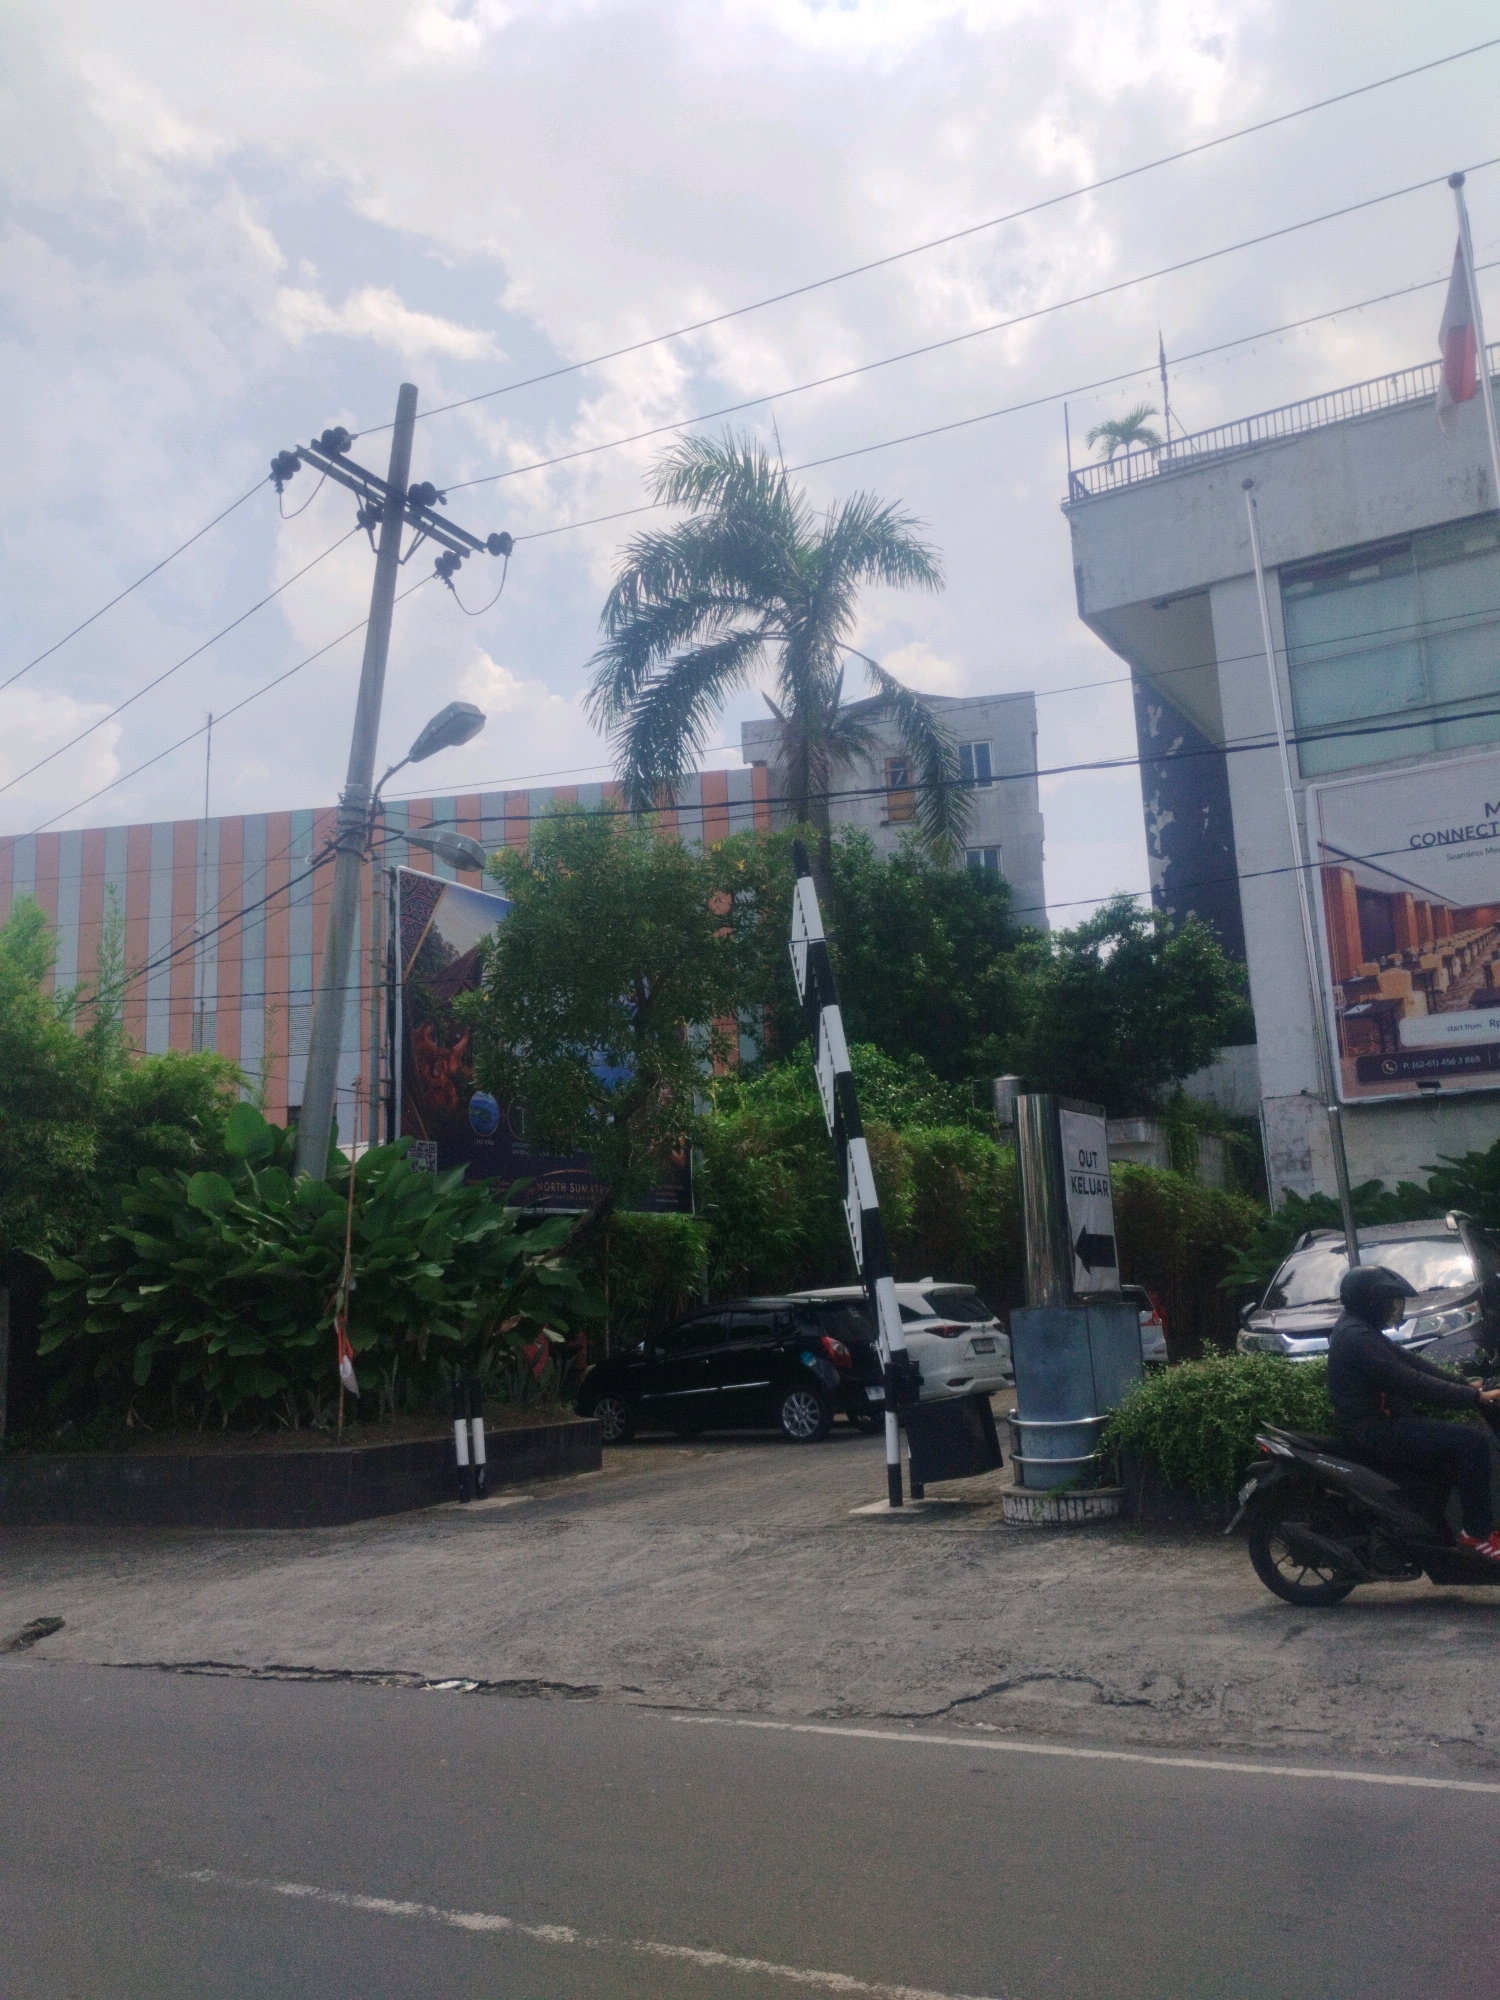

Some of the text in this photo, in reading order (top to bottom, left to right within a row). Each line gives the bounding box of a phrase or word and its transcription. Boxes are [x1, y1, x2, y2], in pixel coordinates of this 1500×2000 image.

[1409, 821, 1499, 848] CONNECT
[1446, 849, 1483, 861] Seamless
[1446, 1024, 1463, 1032] start
[1464, 1023, 1482, 1031] from
[1078, 1149, 1097, 1169] OUT
[536, 1181, 567, 1193] NORTH
[1071, 1175, 1109, 1197] KELUAR
